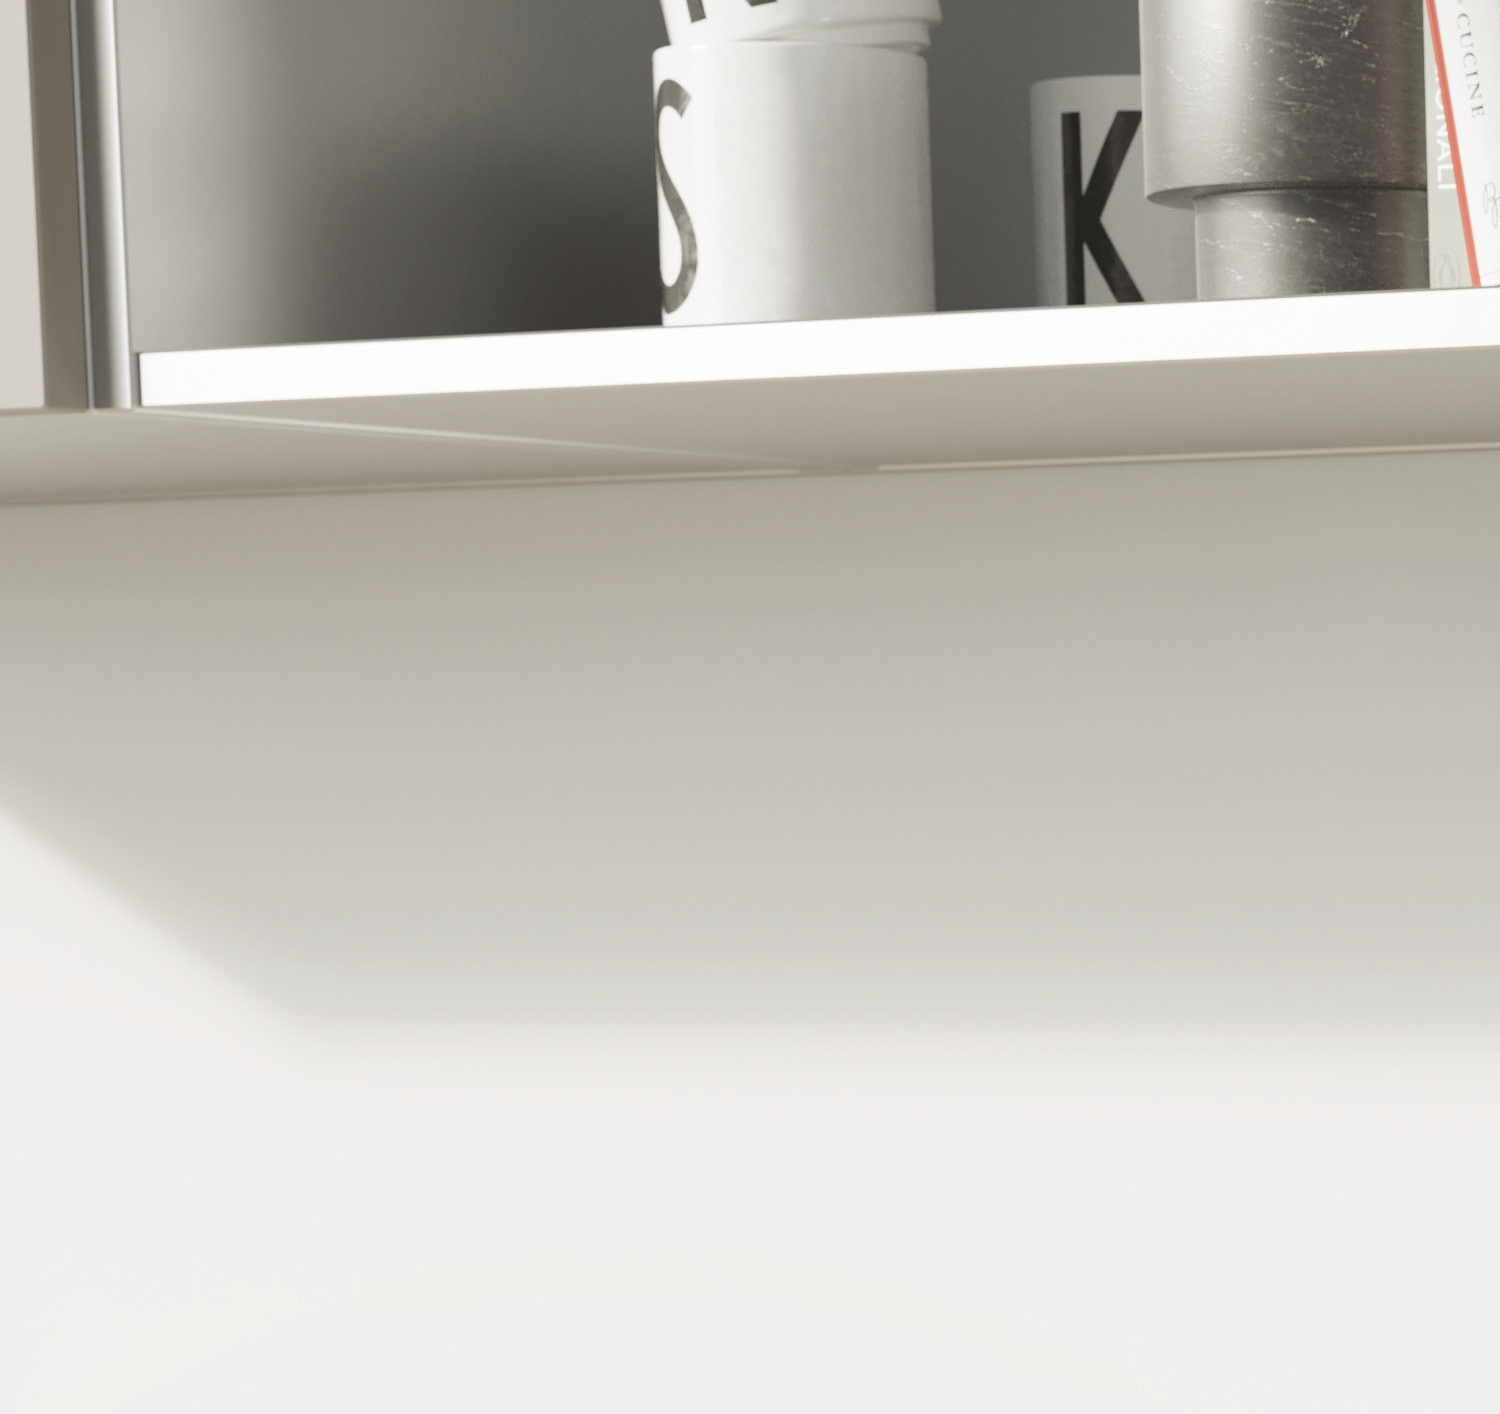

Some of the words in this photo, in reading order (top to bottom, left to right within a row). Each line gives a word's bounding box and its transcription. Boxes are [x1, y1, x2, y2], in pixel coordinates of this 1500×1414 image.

[1457, 13, 1486, 118] CUCINE
[656, 79, 698, 315] S
[1061, 110, 1145, 305] K
